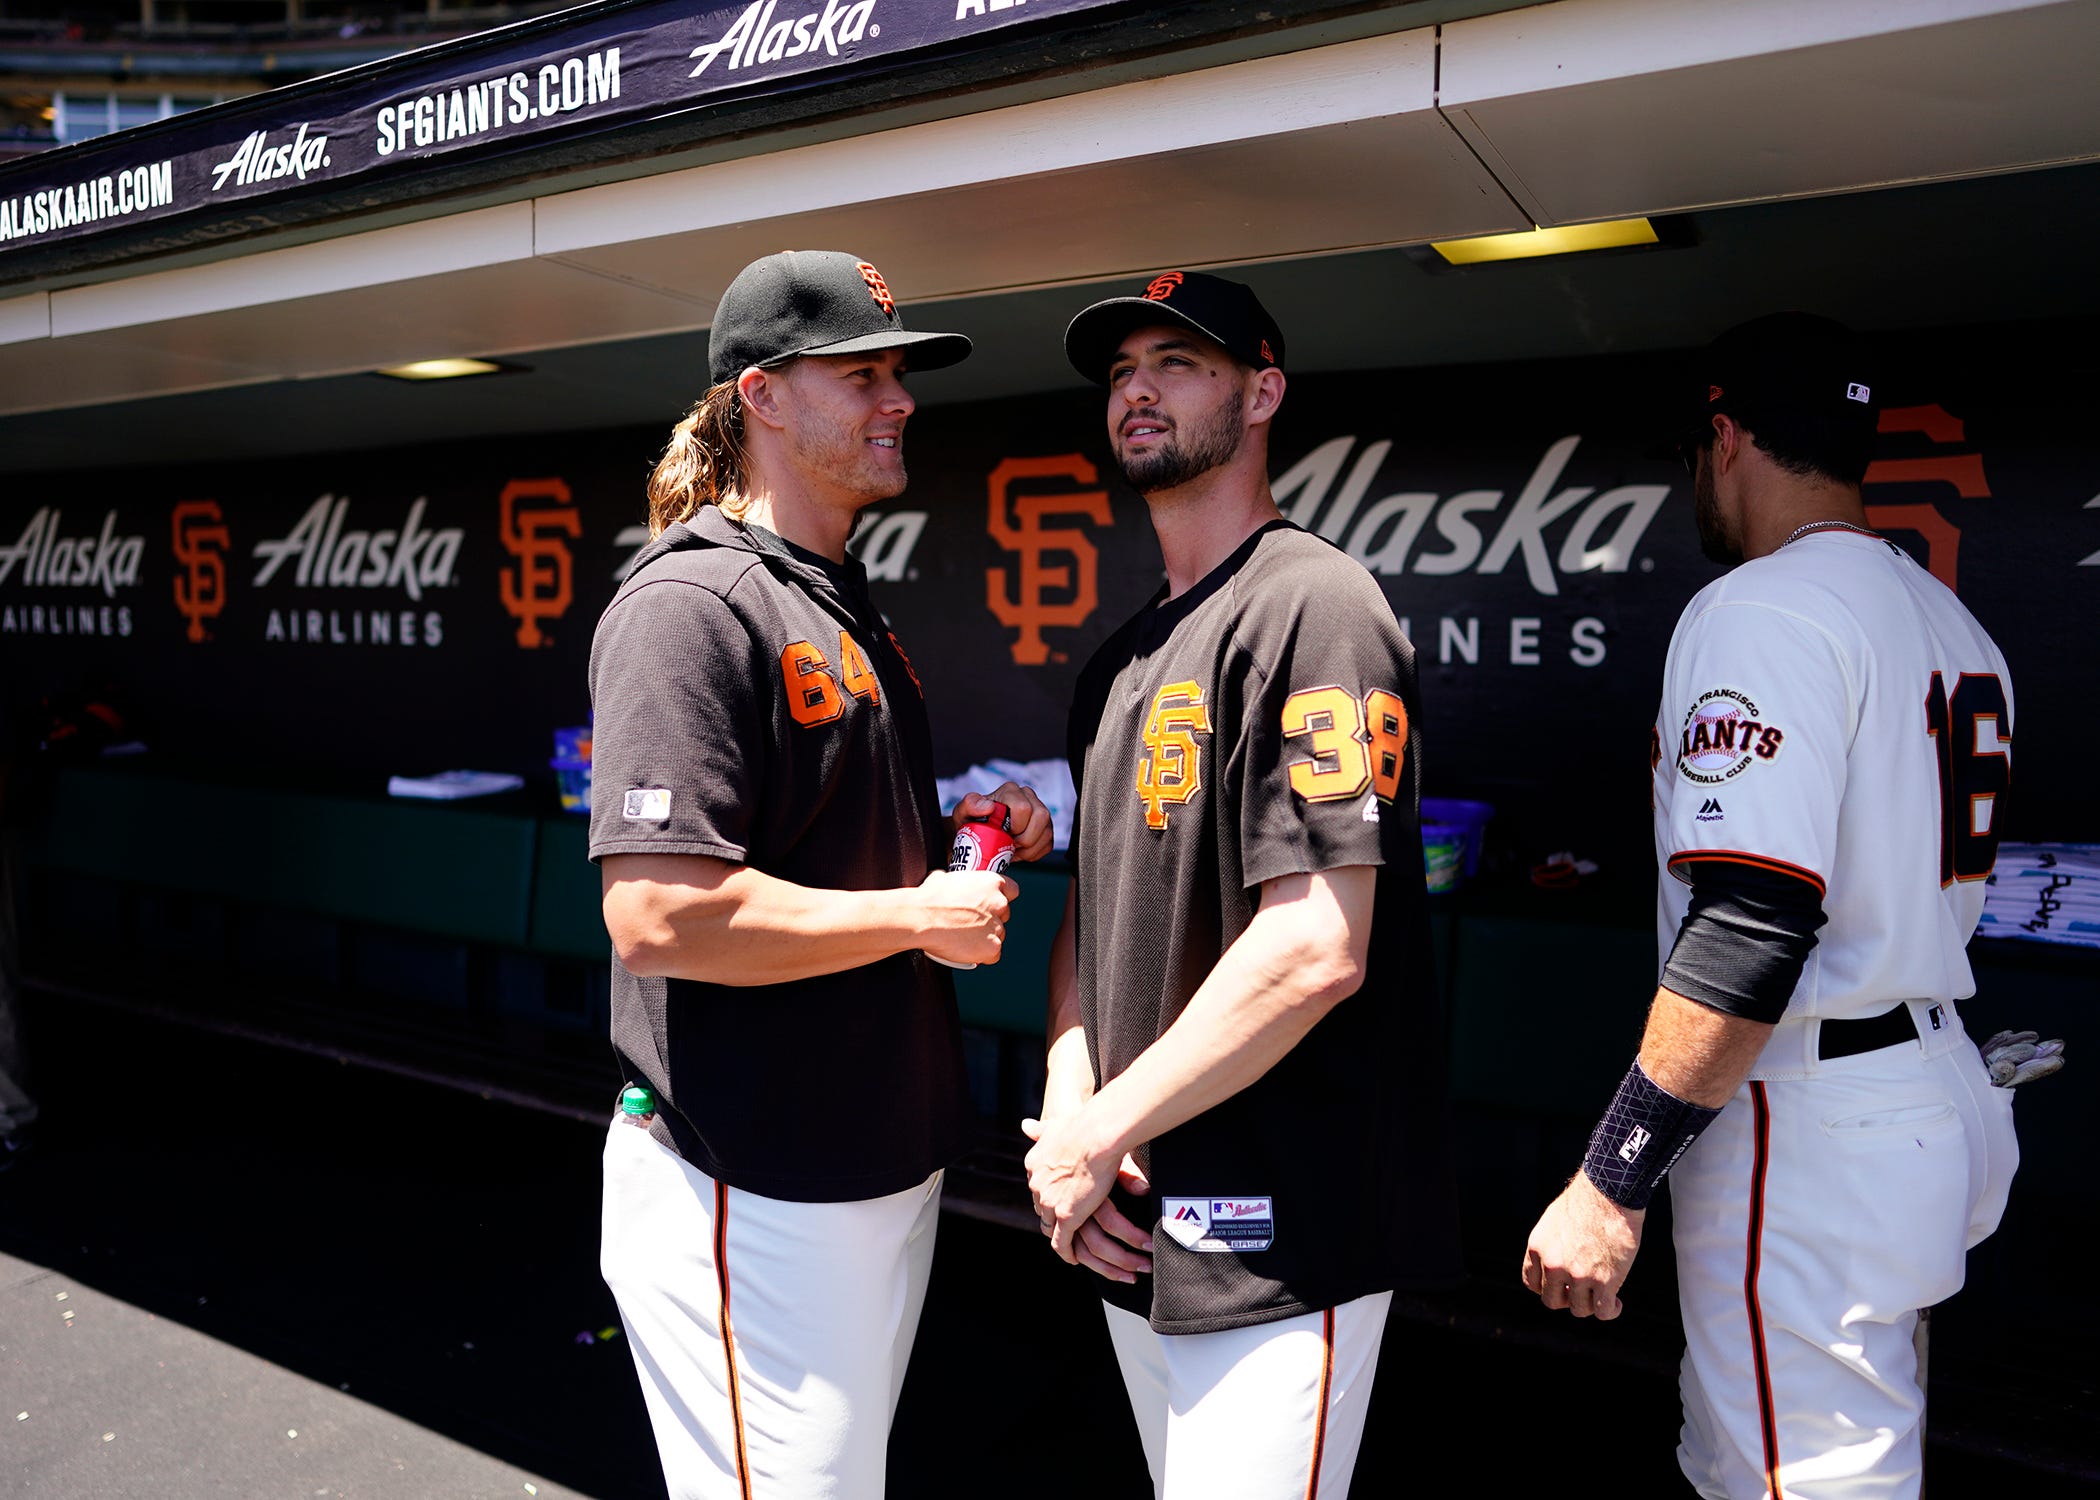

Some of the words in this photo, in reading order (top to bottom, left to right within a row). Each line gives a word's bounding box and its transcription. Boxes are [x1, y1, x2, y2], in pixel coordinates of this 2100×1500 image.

[688, 0, 875, 78] Alaska
[376, 47, 622, 156] SFGIANTS.COM
[0, 160, 173, 242] ALASKAAIR.COM
[211, 121, 331, 191] Alaska
[0, 505, 146, 598] Alaska
[170, 499, 232, 644] SF
[251, 492, 466, 602] Alaska
[499, 477, 583, 649] SF
[985, 453, 1116, 666] SF
[2, 604, 133, 637] AIRLINES
[265, 610, 444, 647] AIRLINES
[778, 629, 882, 729] 64
[1699, 689, 1759, 717] FRANCISCO
[1136, 679, 1213, 830] SF
[1281, 684, 1409, 805] 38
[1676, 719, 1784, 768] IANTS
[1726, 756, 1752, 778] CLUB
[1925, 670, 2013, 889] 16
